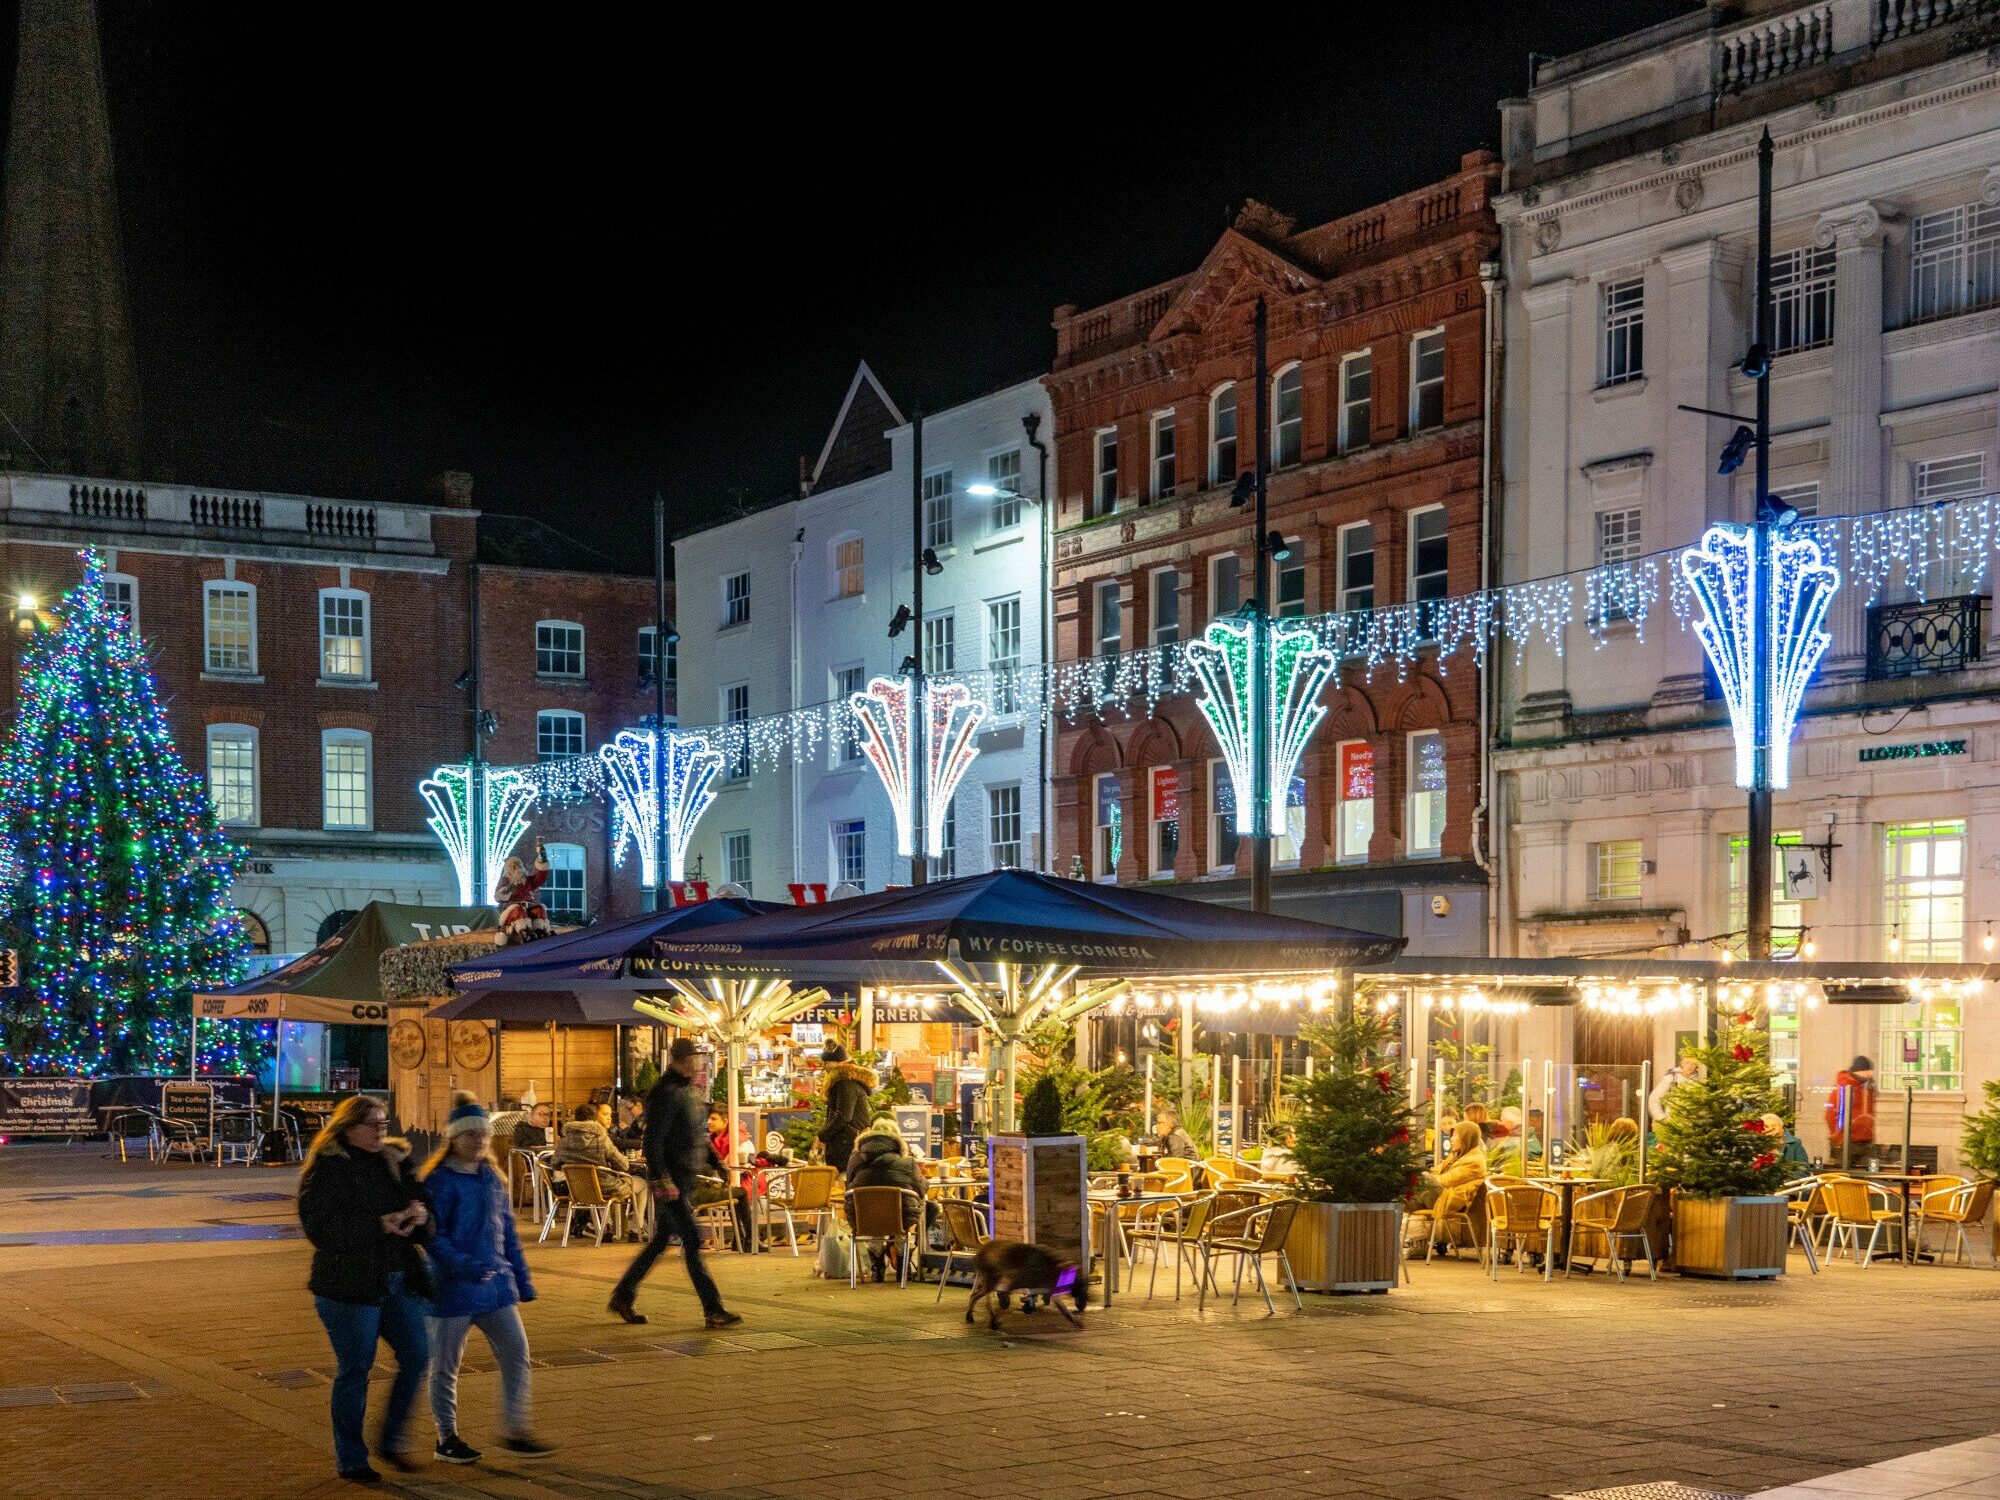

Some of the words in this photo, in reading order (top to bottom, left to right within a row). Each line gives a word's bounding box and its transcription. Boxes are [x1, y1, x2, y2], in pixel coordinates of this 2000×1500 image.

[1859, 745, 1918, 762] LLOYDS
[1920, 740, 1966, 757] BANK
[969, 937, 994, 951] MY
[1000, 939, 1068, 955] COFFEE
[1071, 944, 1141, 959] CORNER
[634, 958, 655, 971] MY
[16, 1081, 54, 1090] Something
[21, 1096, 73, 1107] Christmas
